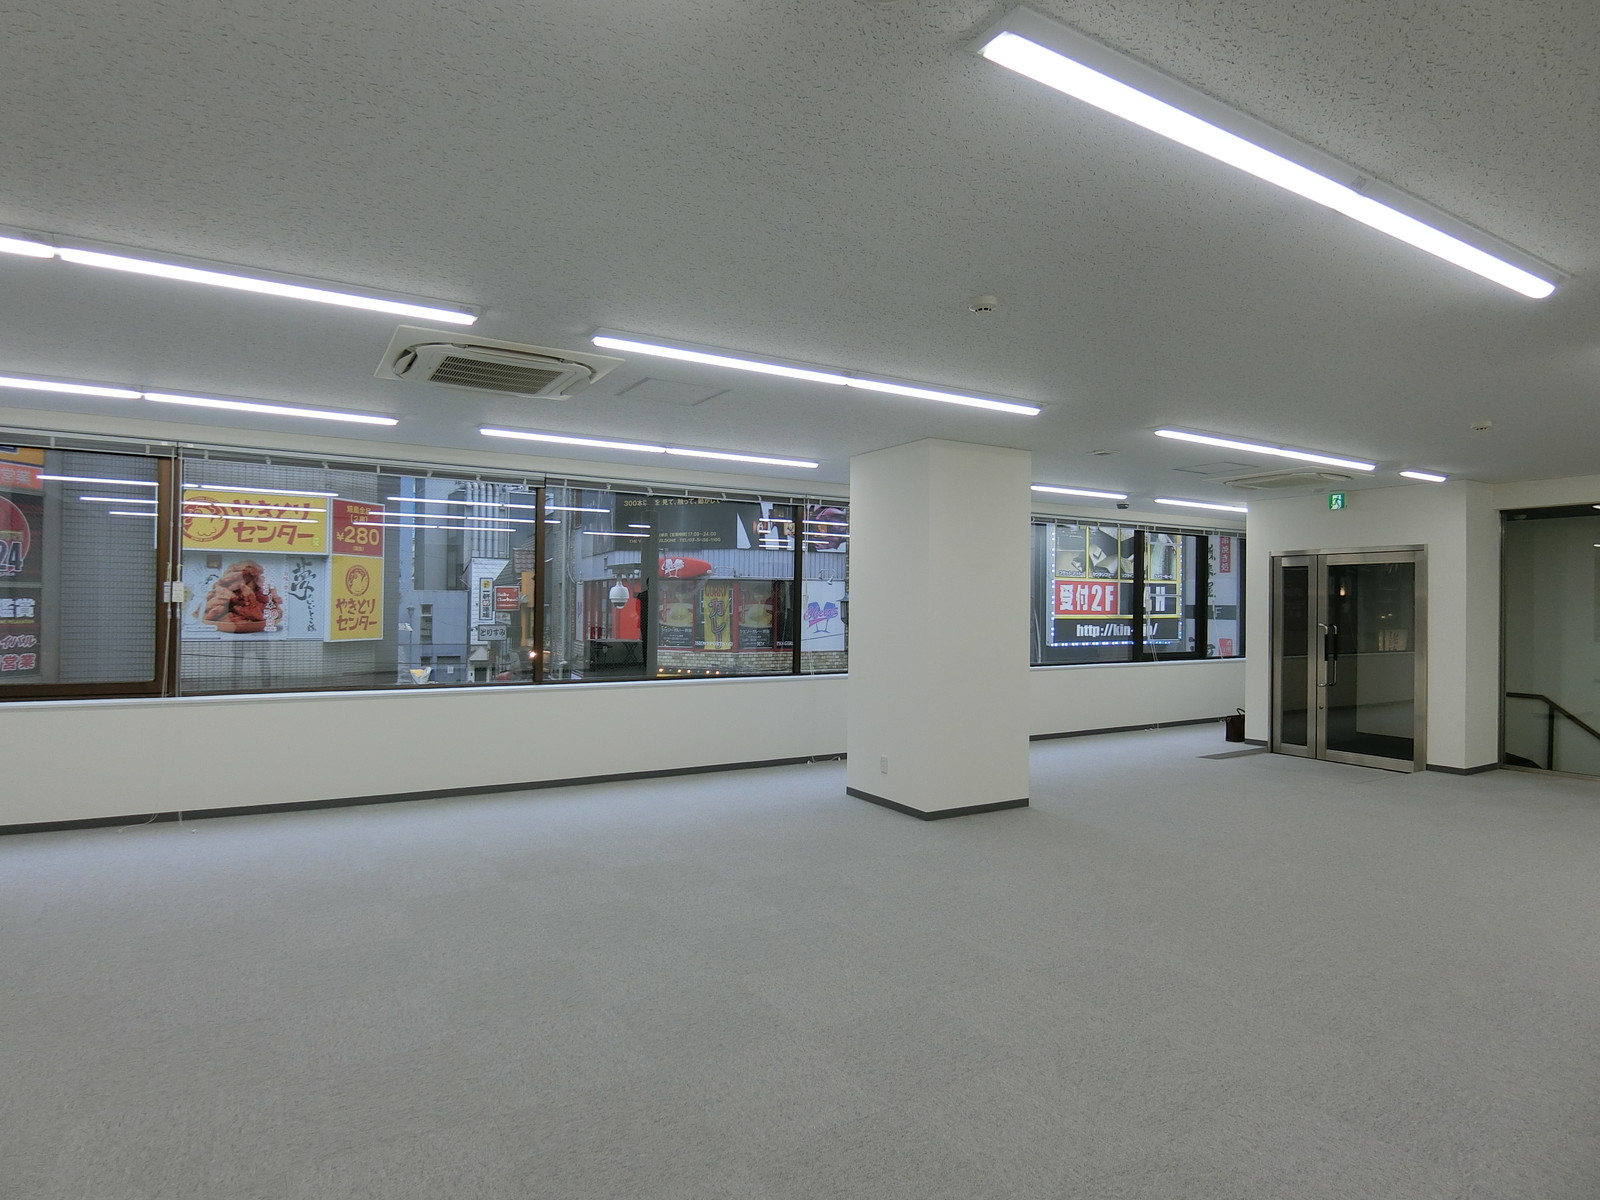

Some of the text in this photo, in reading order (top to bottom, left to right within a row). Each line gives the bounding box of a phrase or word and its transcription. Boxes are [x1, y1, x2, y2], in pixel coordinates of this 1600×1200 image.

[232, 522, 315, 545] センター
[336, 526, 380, 546] ¥280
[336, 598, 376, 614] やきとり
[336, 615, 378, 631] センター
